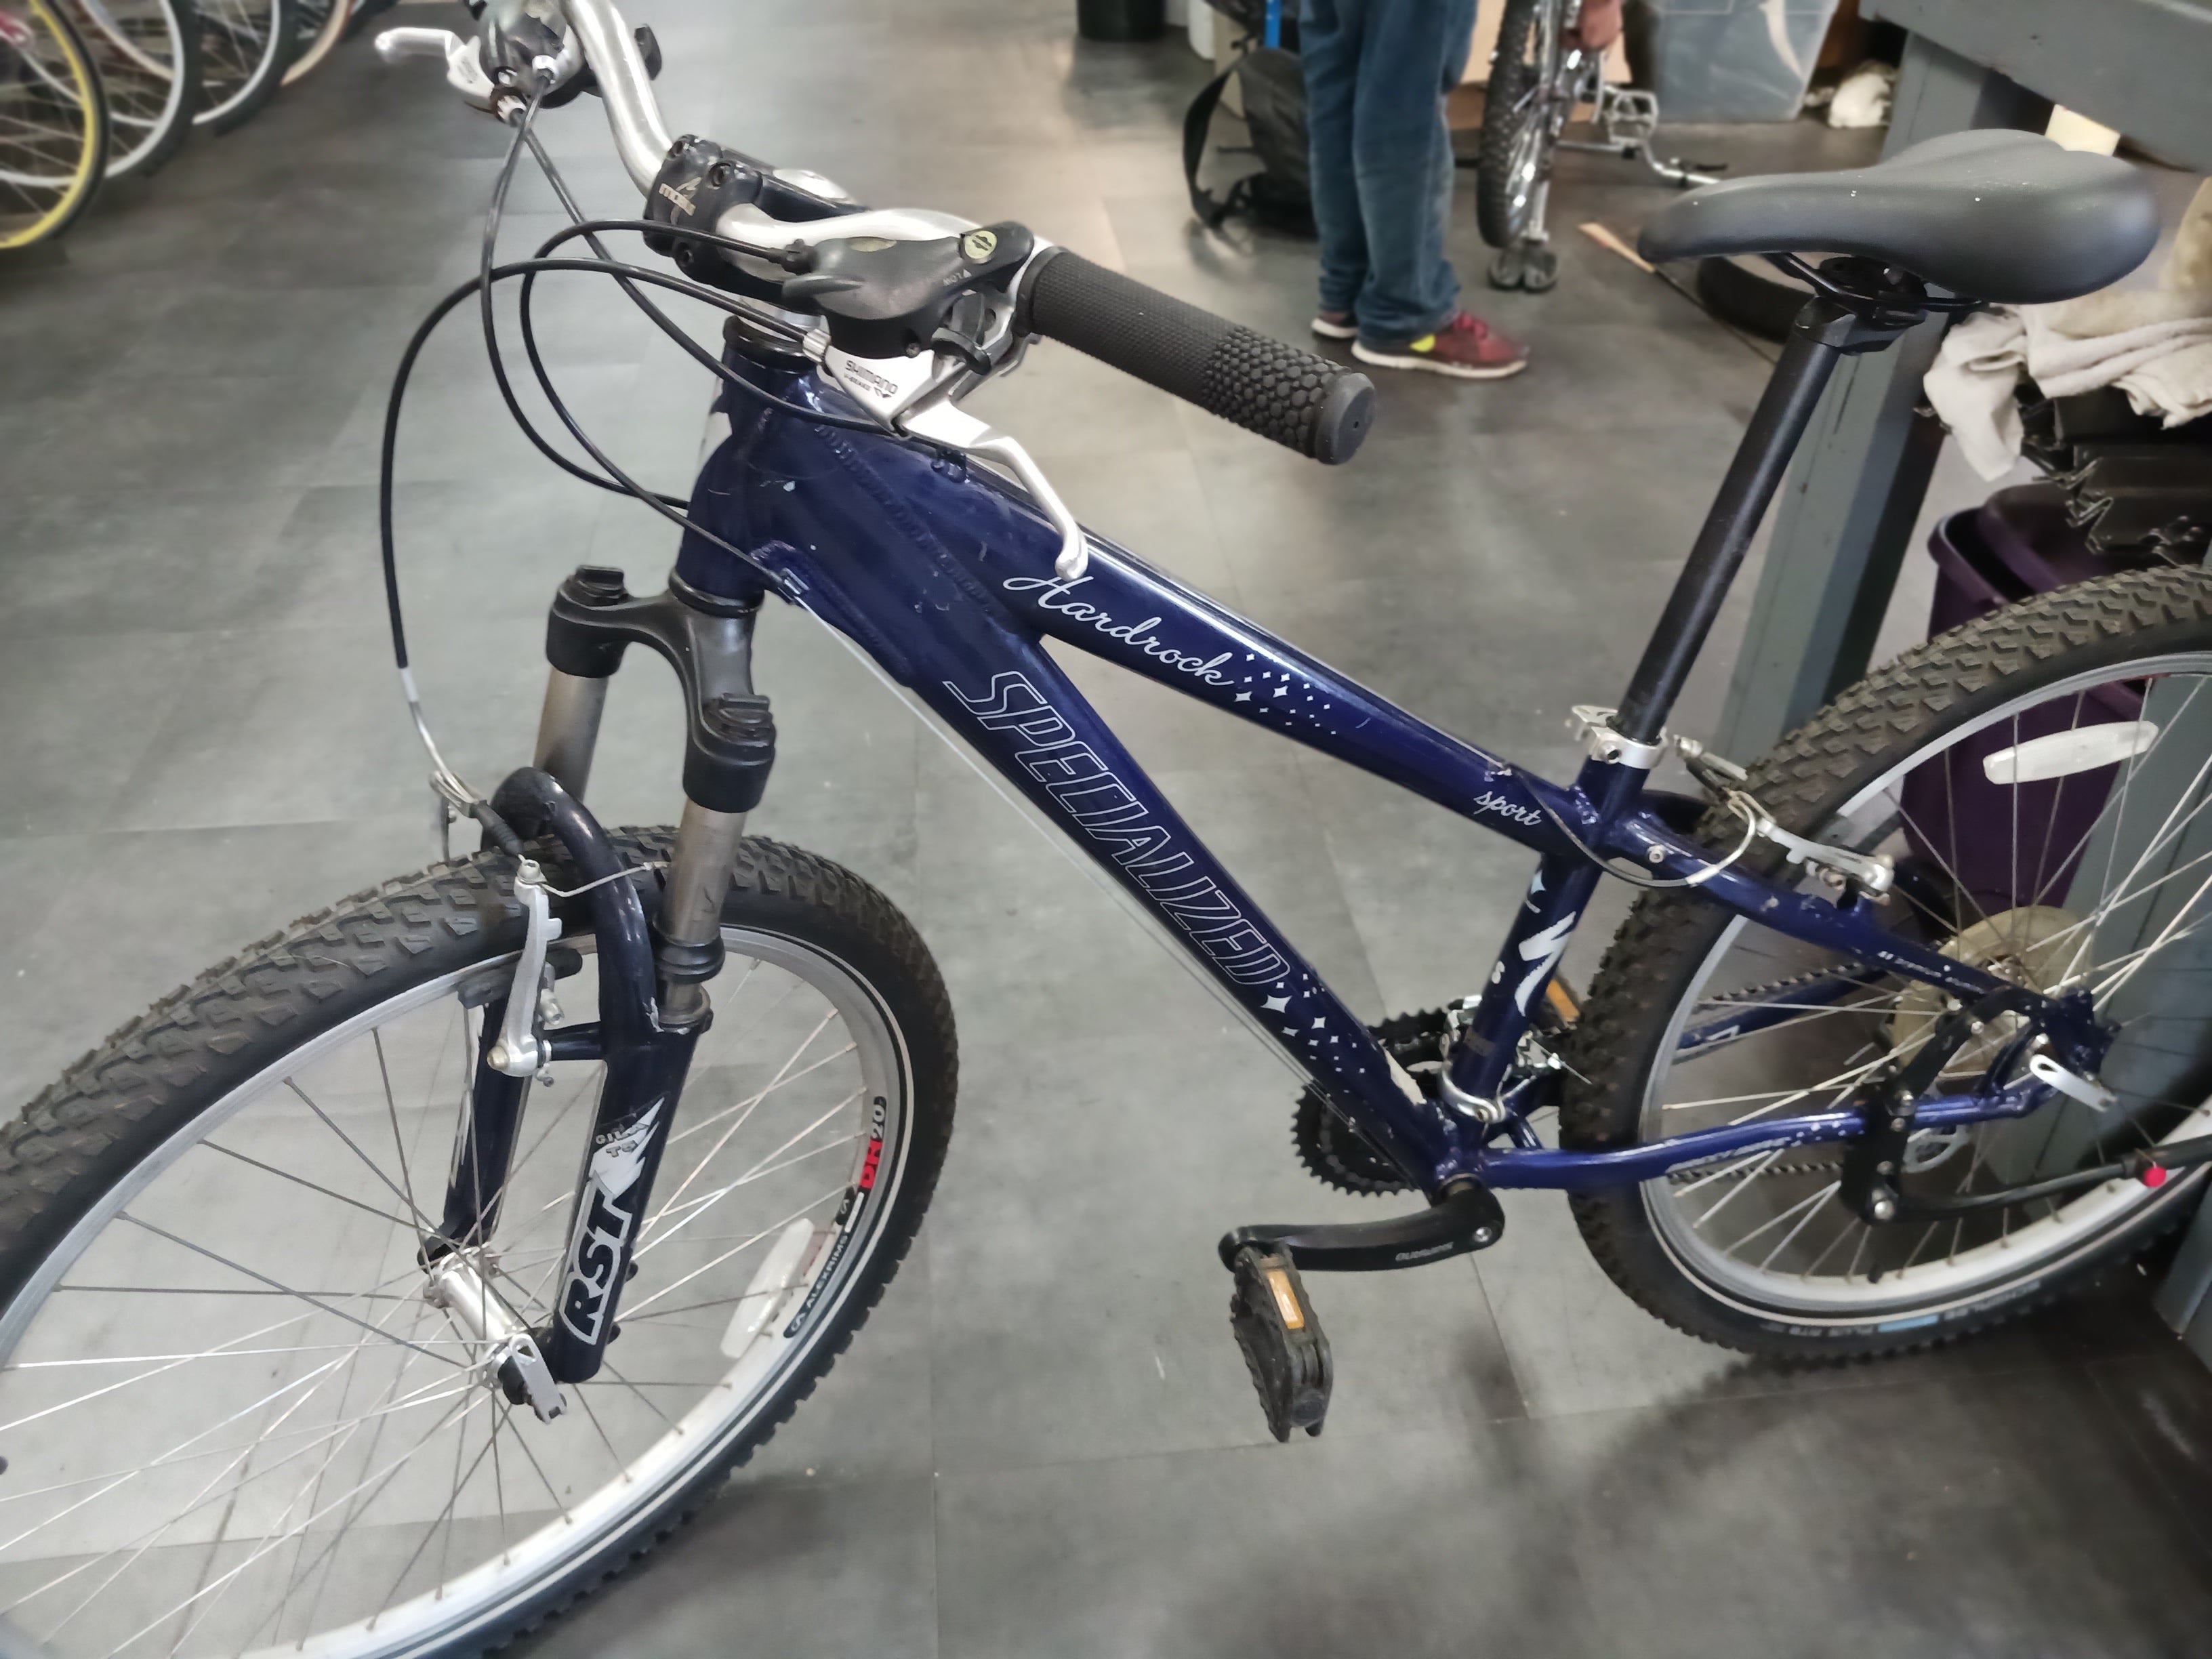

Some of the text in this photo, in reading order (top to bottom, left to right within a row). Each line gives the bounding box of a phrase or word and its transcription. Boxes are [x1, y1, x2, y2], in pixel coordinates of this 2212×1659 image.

[1002, 576, 1235, 686] Hardrock
[942, 671, 1290, 985] SPECIALIZED
[1473, 790, 1542, 825] sport
[561, 1183, 629, 1342] RST
